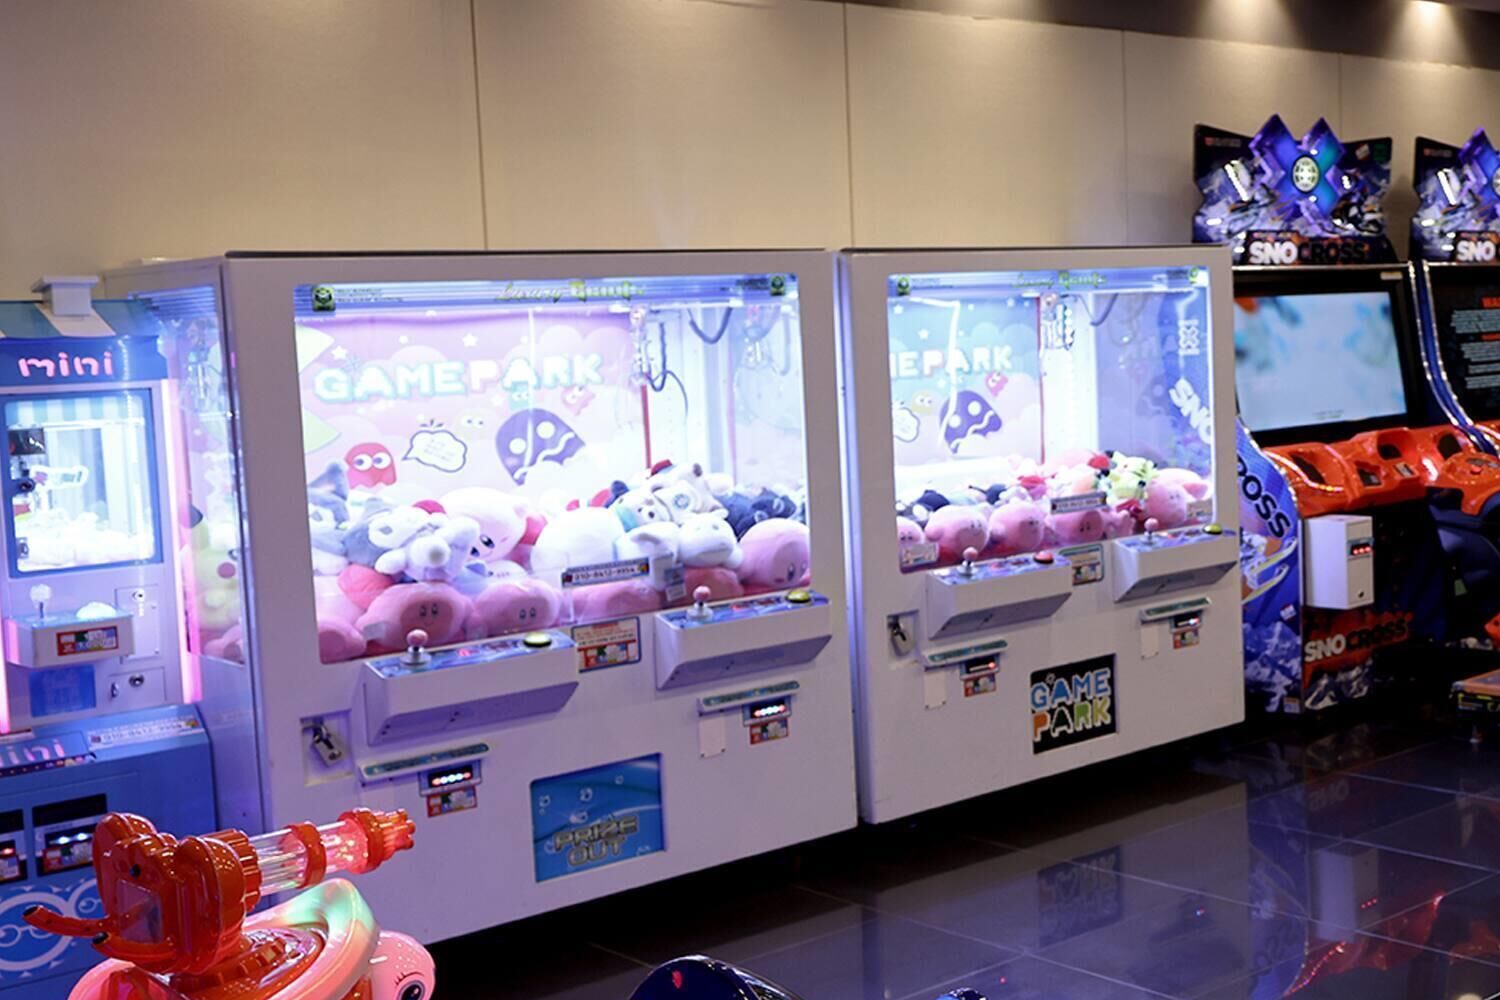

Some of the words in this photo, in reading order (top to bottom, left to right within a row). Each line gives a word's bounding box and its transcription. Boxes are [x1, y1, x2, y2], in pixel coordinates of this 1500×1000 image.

[18, 351, 113, 377] mini
[1030, 666, 1111, 711] GAME
[1033, 695, 1111, 742] PARK
[0, 737, 66, 768] ini
[554, 813, 640, 852] PRIZE
[567, 835, 628, 867] OUT
